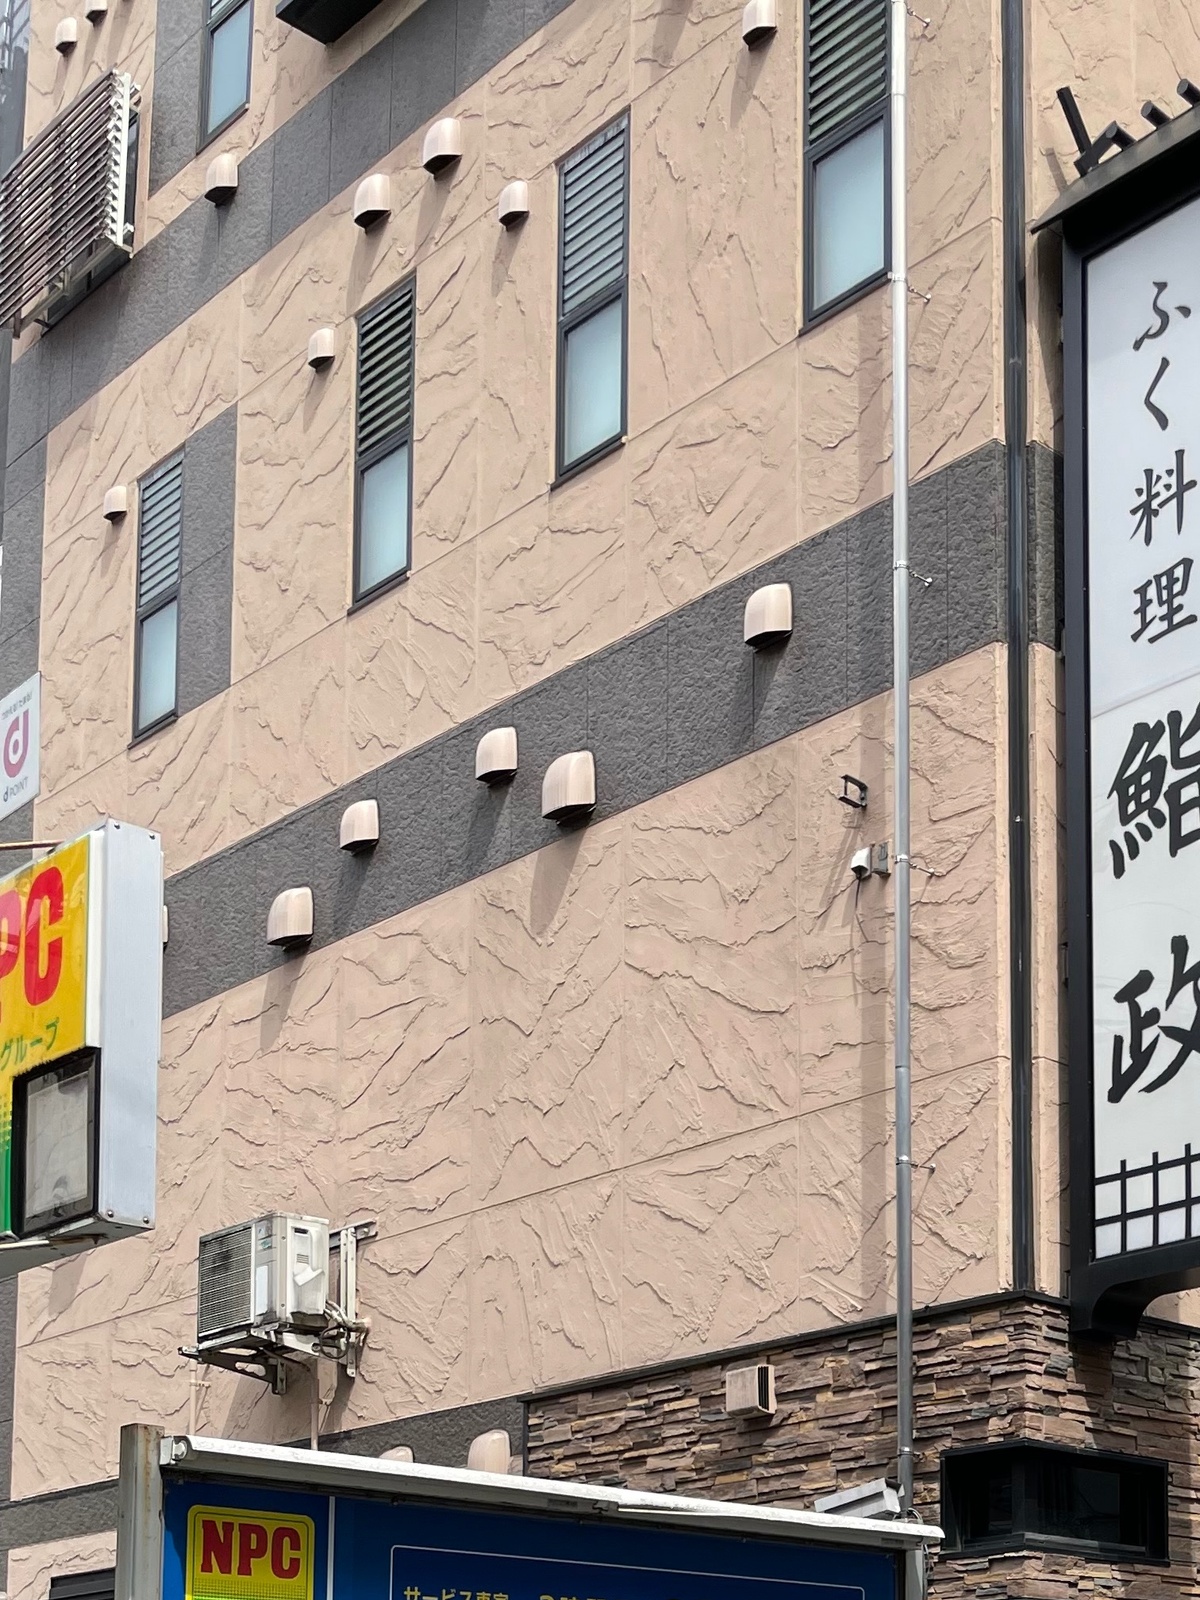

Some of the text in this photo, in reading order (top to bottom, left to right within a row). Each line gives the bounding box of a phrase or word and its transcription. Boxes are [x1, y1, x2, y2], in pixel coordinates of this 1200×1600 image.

[1129, 281, 1198, 645] ふく料理
[200, 1519, 302, 1580] NPC
